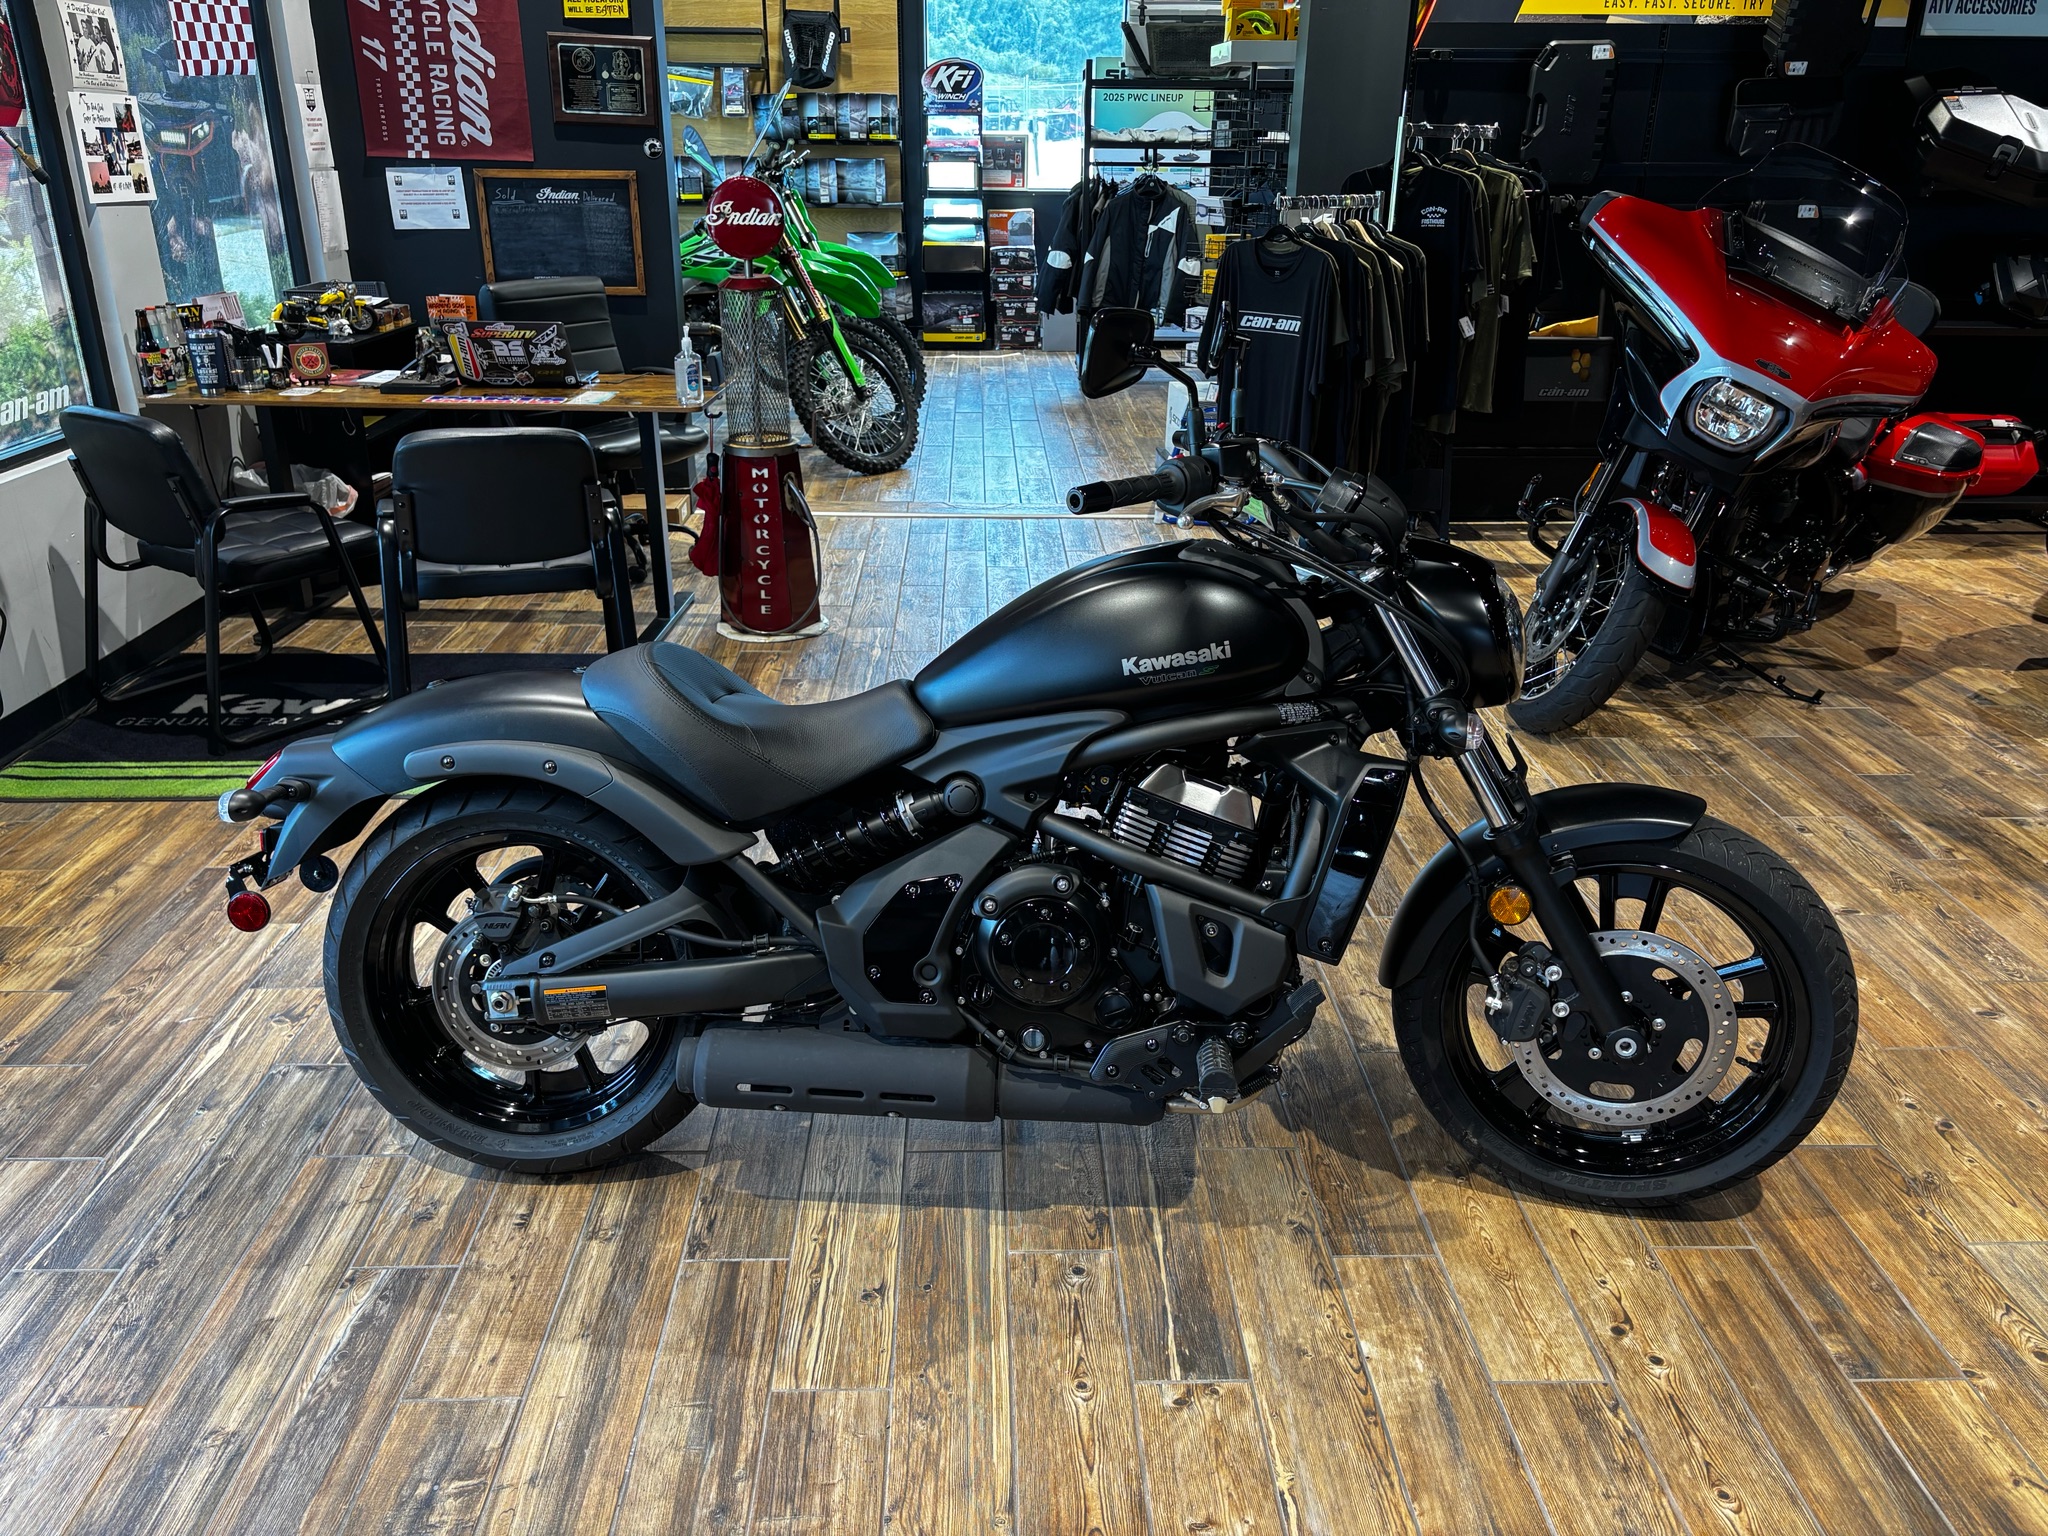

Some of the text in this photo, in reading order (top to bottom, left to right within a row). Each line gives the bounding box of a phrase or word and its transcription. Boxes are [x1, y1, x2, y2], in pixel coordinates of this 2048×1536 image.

[596, 4, 626, 16] EATEN
[1955, 0, 2037, 15] ACCESSORIES
[361, 35, 388, 72] 17
[428, 63, 456, 145] RACING
[1103, 93, 1184, 102] 2025 PWC LINEUP
[375, 78, 389, 141] TROY HERFOSS
[494, 187, 517, 200] Sold
[536, 186, 580, 201] Indian
[582, 190, 616, 202] Delivered
[706, 200, 783, 226] Indian
[1240, 314, 1301, 332] can-am
[1538, 388, 1590, 397] can-am
[751, 467, 772, 615] MOTORCYCLE
[1121, 640, 1232, 676] Kawasaki
[1138, 668, 1197, 686] Vulcan
[405, 1099, 488, 1145] DUNLOP
[1535, 1166, 1669, 1193] SPORTMAX
